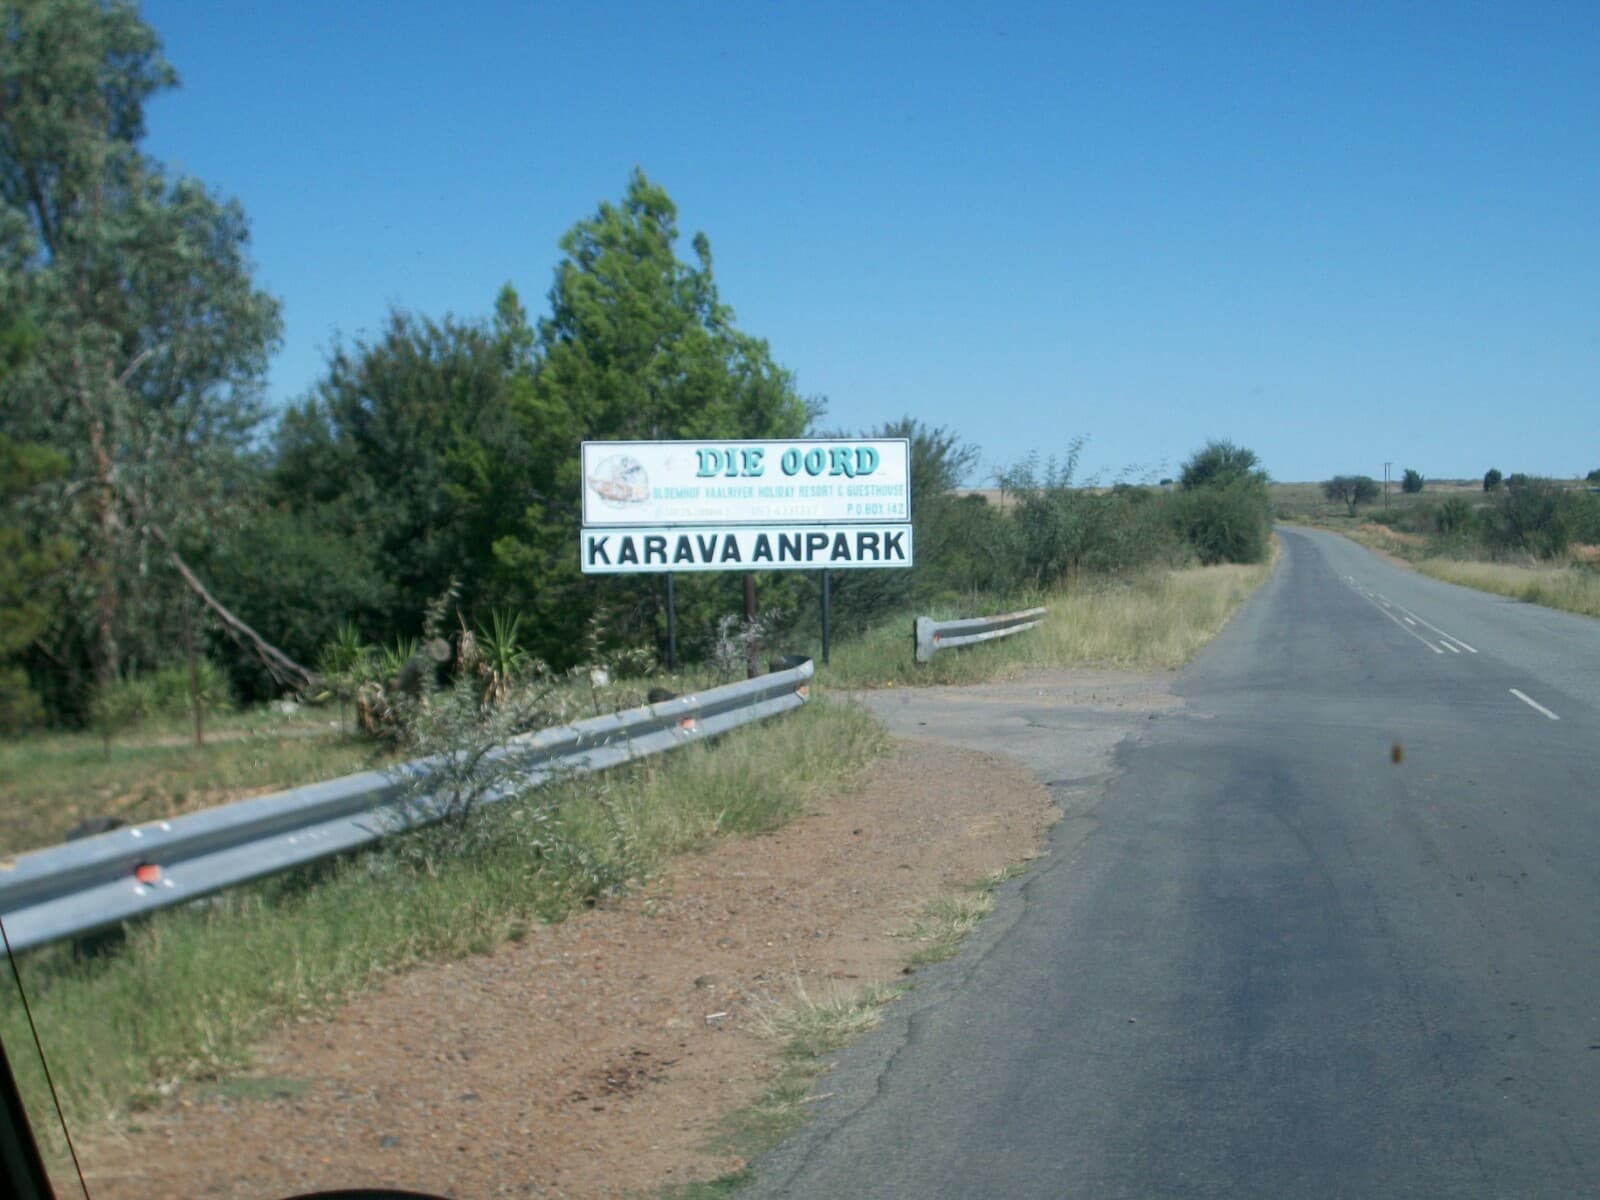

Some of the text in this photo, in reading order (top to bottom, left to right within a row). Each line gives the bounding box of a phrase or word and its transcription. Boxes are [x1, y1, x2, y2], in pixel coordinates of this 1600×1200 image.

[696, 446, 880, 478] DIE OORD
[758, 485, 794, 498] HOLIDAY
[799, 484, 833, 497] RESORT
[847, 484, 905, 497] GUESTHOUSE
[864, 503, 884, 515] BOX
